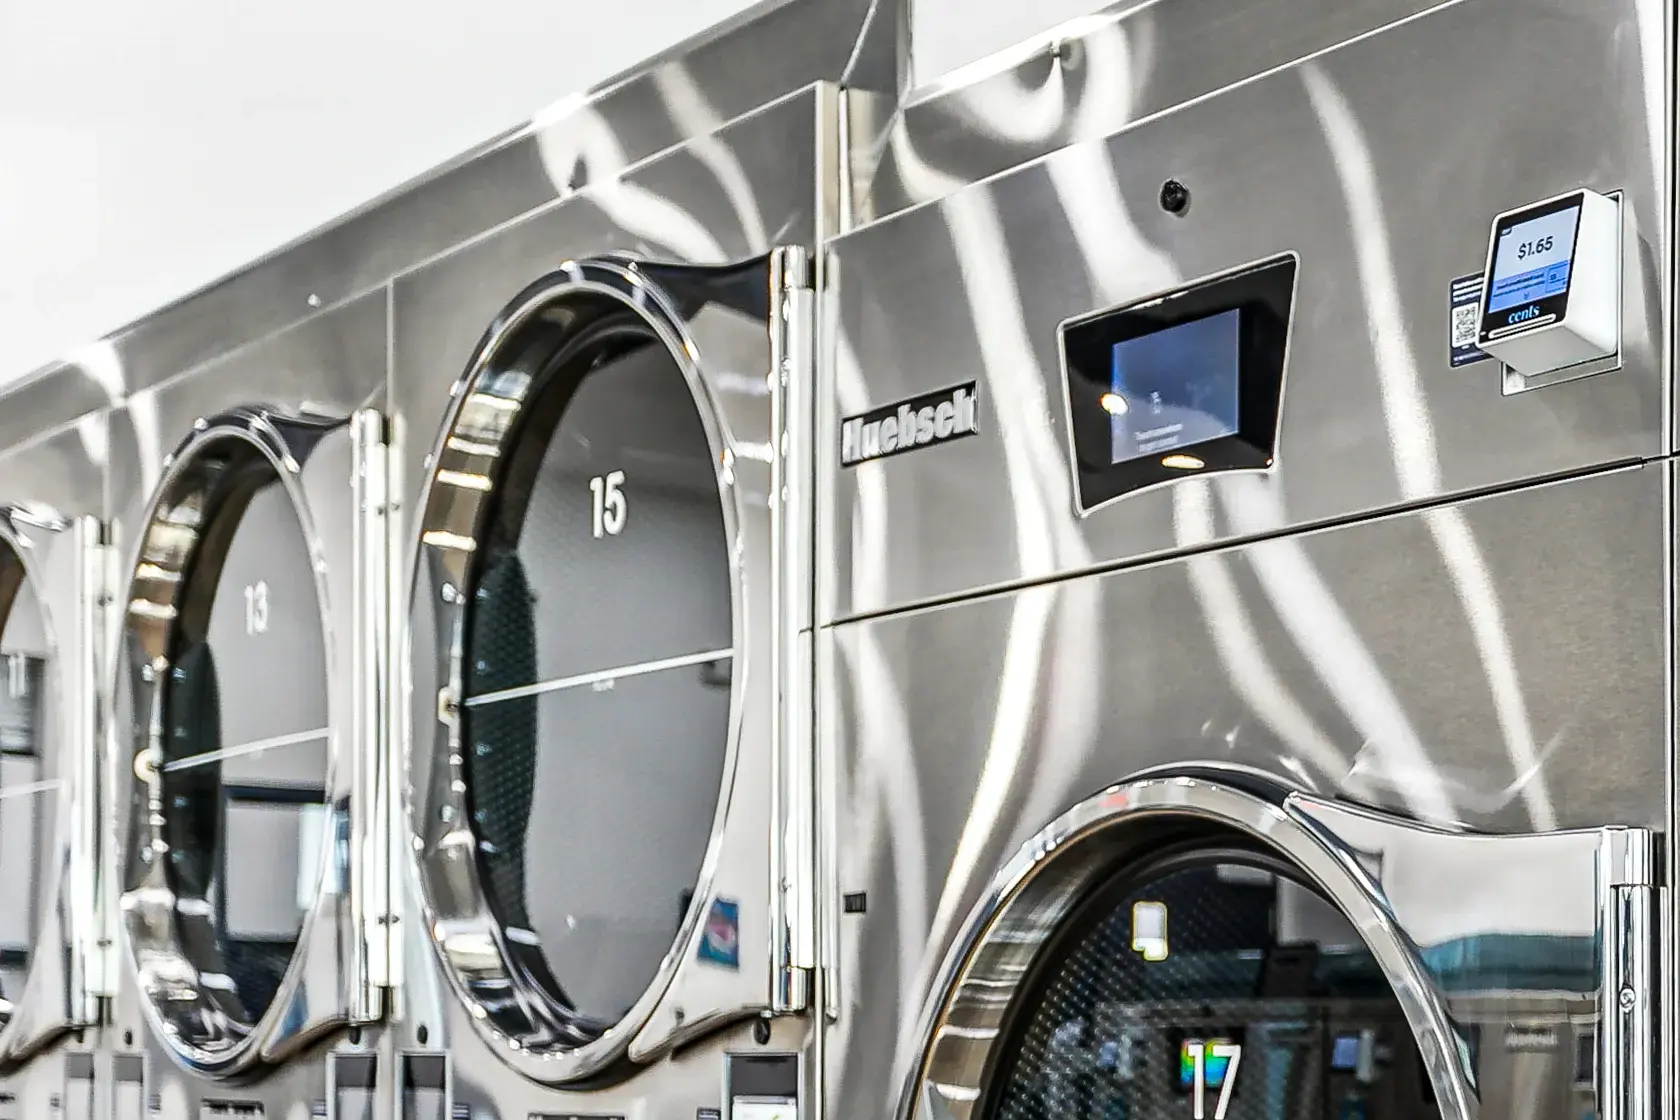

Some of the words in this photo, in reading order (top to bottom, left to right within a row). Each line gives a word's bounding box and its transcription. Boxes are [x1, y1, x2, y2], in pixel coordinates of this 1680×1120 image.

[1517, 235, 1554, 261] $1.65
[842, 388, 974, 463] Huebsch
[589, 470, 627, 538] 15
[1187, 1044, 1241, 1120] 17
